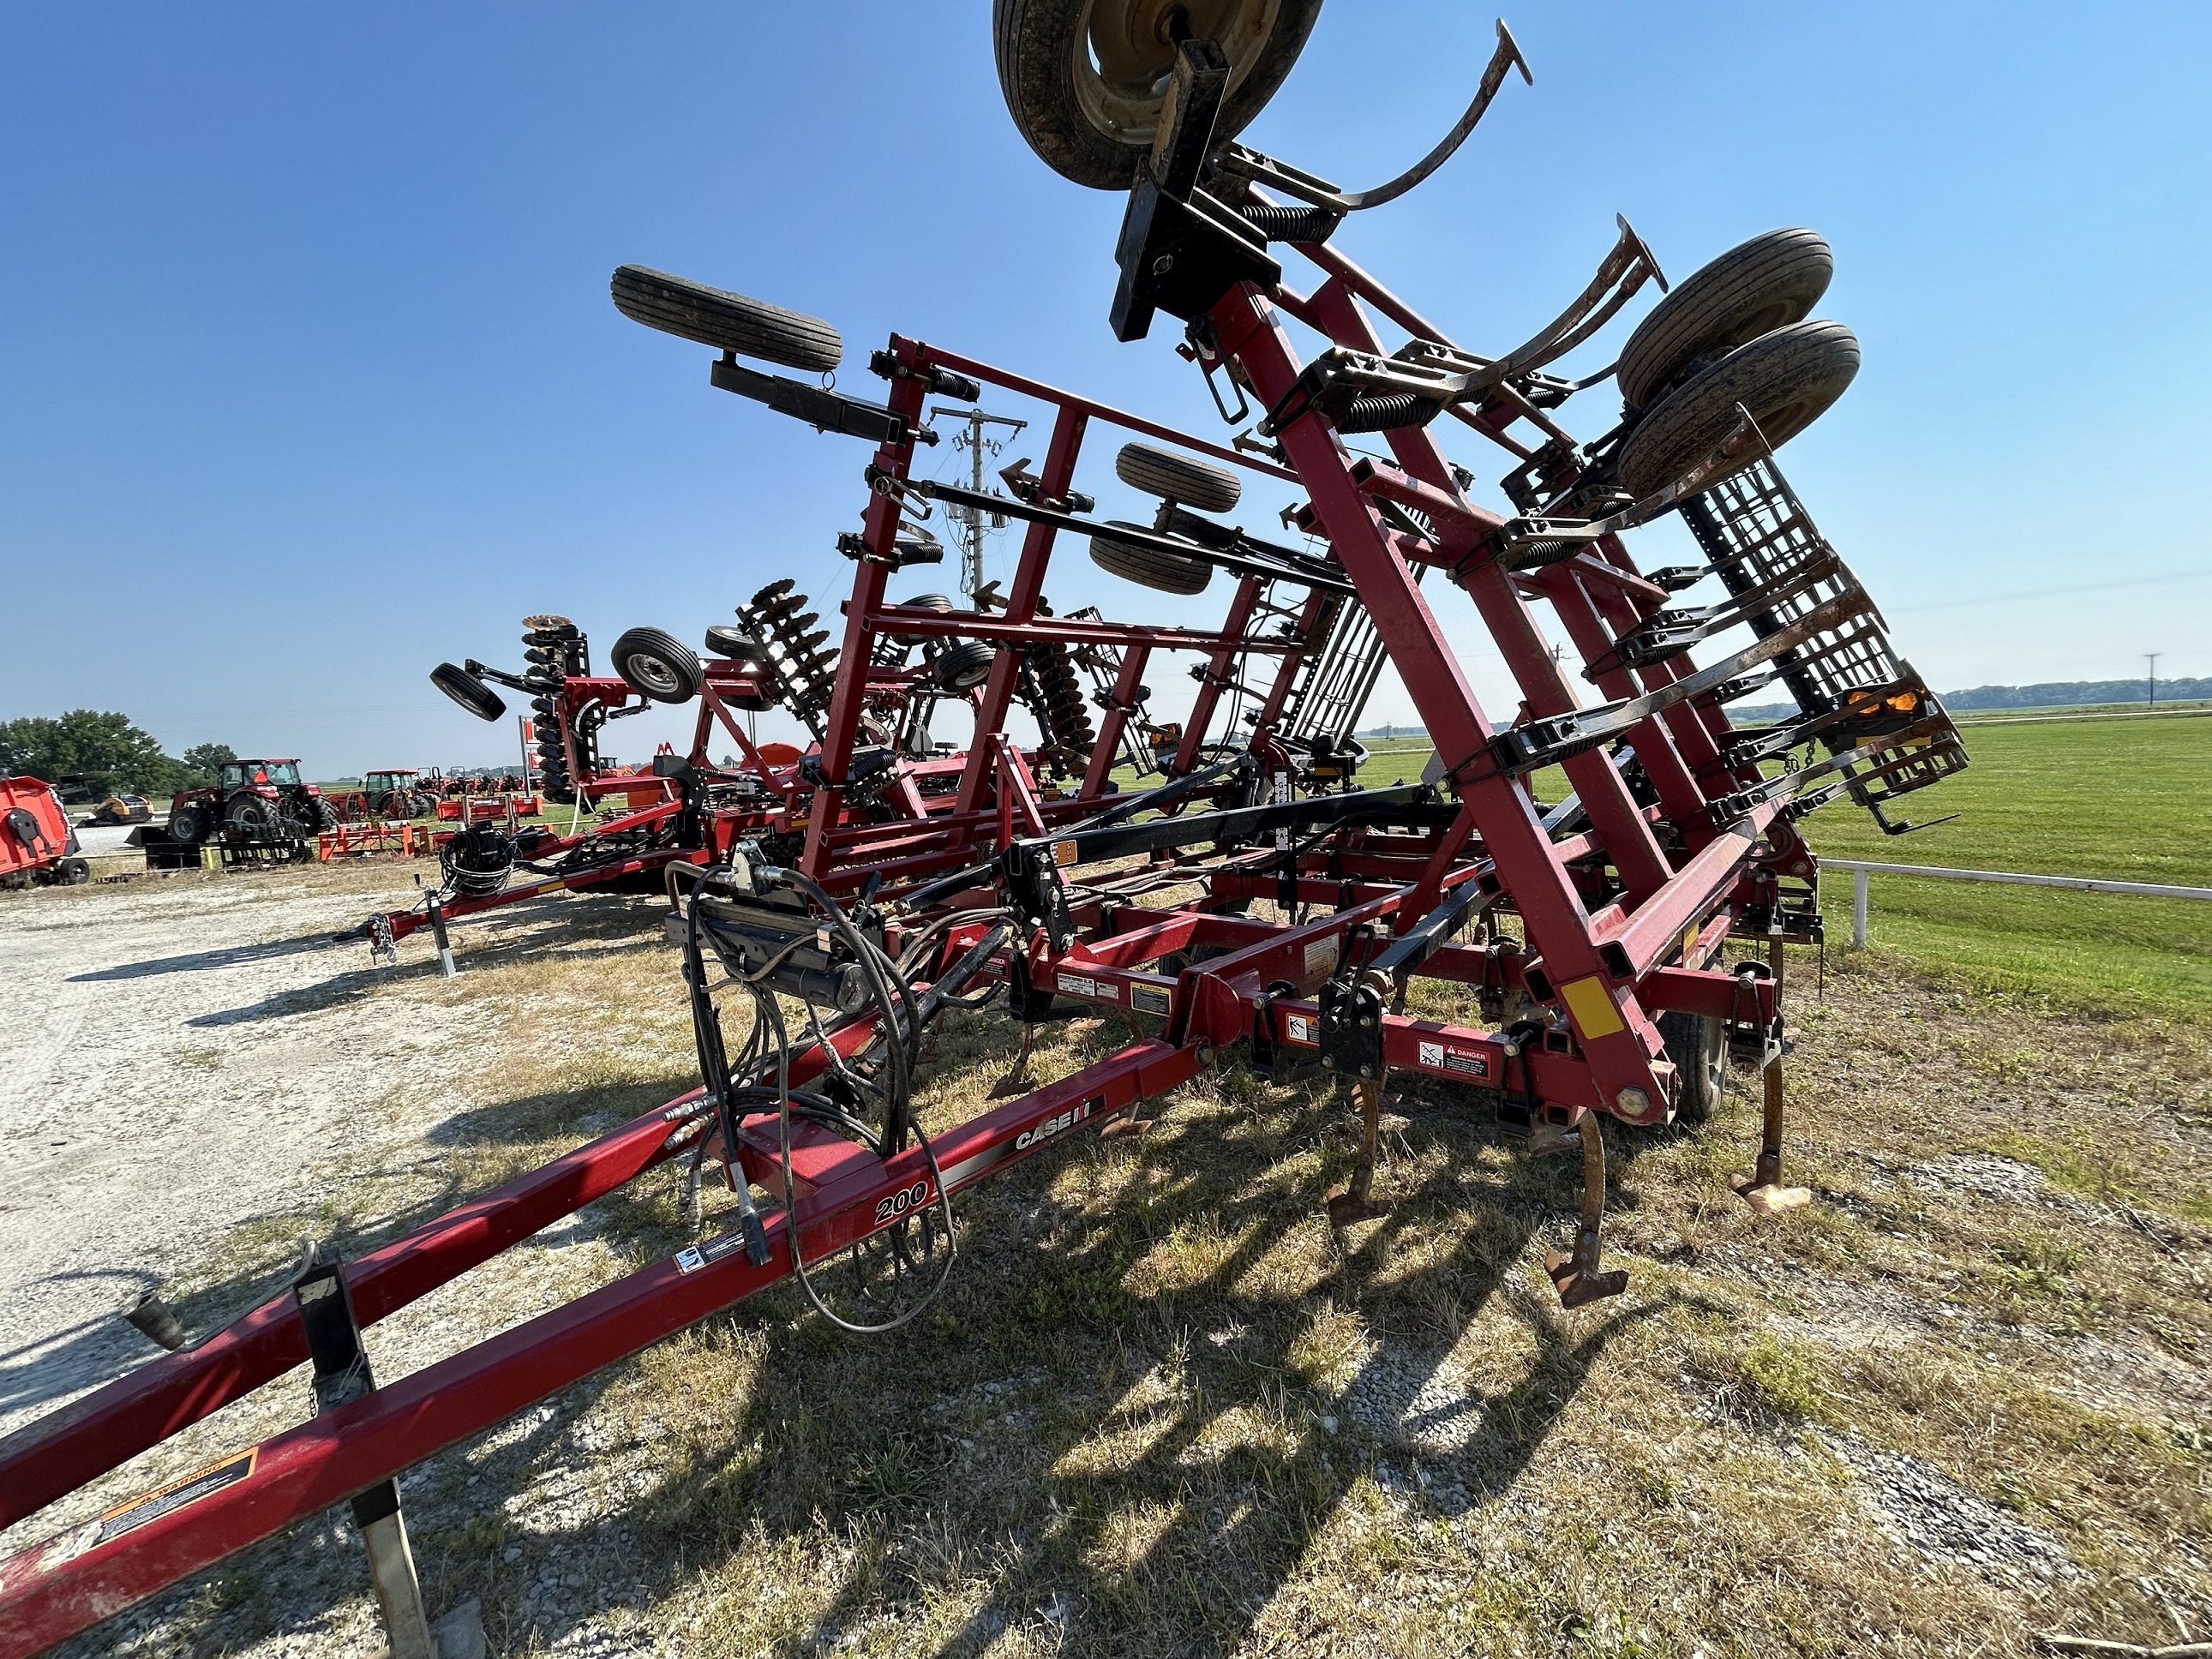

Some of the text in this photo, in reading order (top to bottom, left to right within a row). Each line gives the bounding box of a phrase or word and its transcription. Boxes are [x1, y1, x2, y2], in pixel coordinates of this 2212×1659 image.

[1457, 1050, 1485, 1059] DANGER
[1016, 1111, 1072, 1150] CASE
[874, 1180, 928, 1225] 200
[159, 1464, 222, 1495] WARNING
